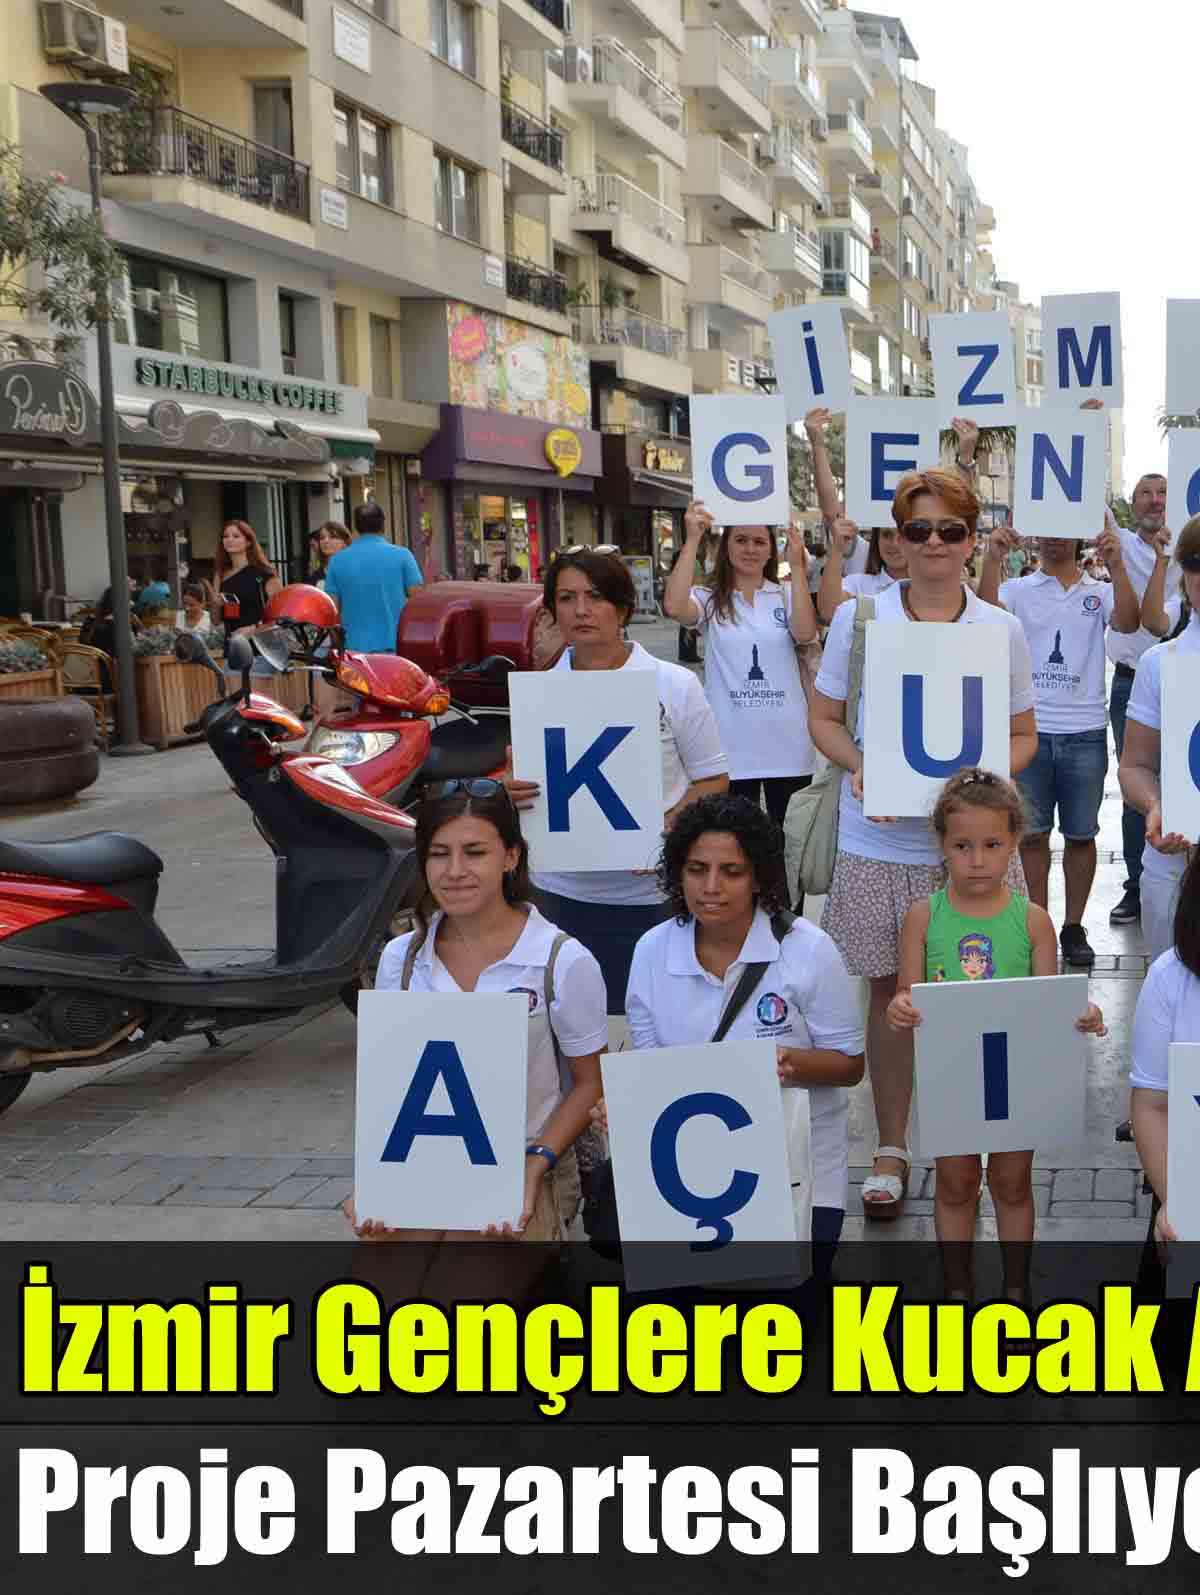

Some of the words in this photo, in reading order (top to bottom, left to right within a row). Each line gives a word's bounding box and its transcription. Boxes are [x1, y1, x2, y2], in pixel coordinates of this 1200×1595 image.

[136, 357, 274, 401] STARBUCKS
[277, 384, 345, 415] COFFEE
[957, 344, 1005, 406] Z
[1057, 325, 1113, 388] M
[711, 433, 775, 502] G
[1031, 433, 1085, 503] N
[902, 674, 984, 779] U
[544, 726, 641, 832] K
[380, 1040, 498, 1166] A
